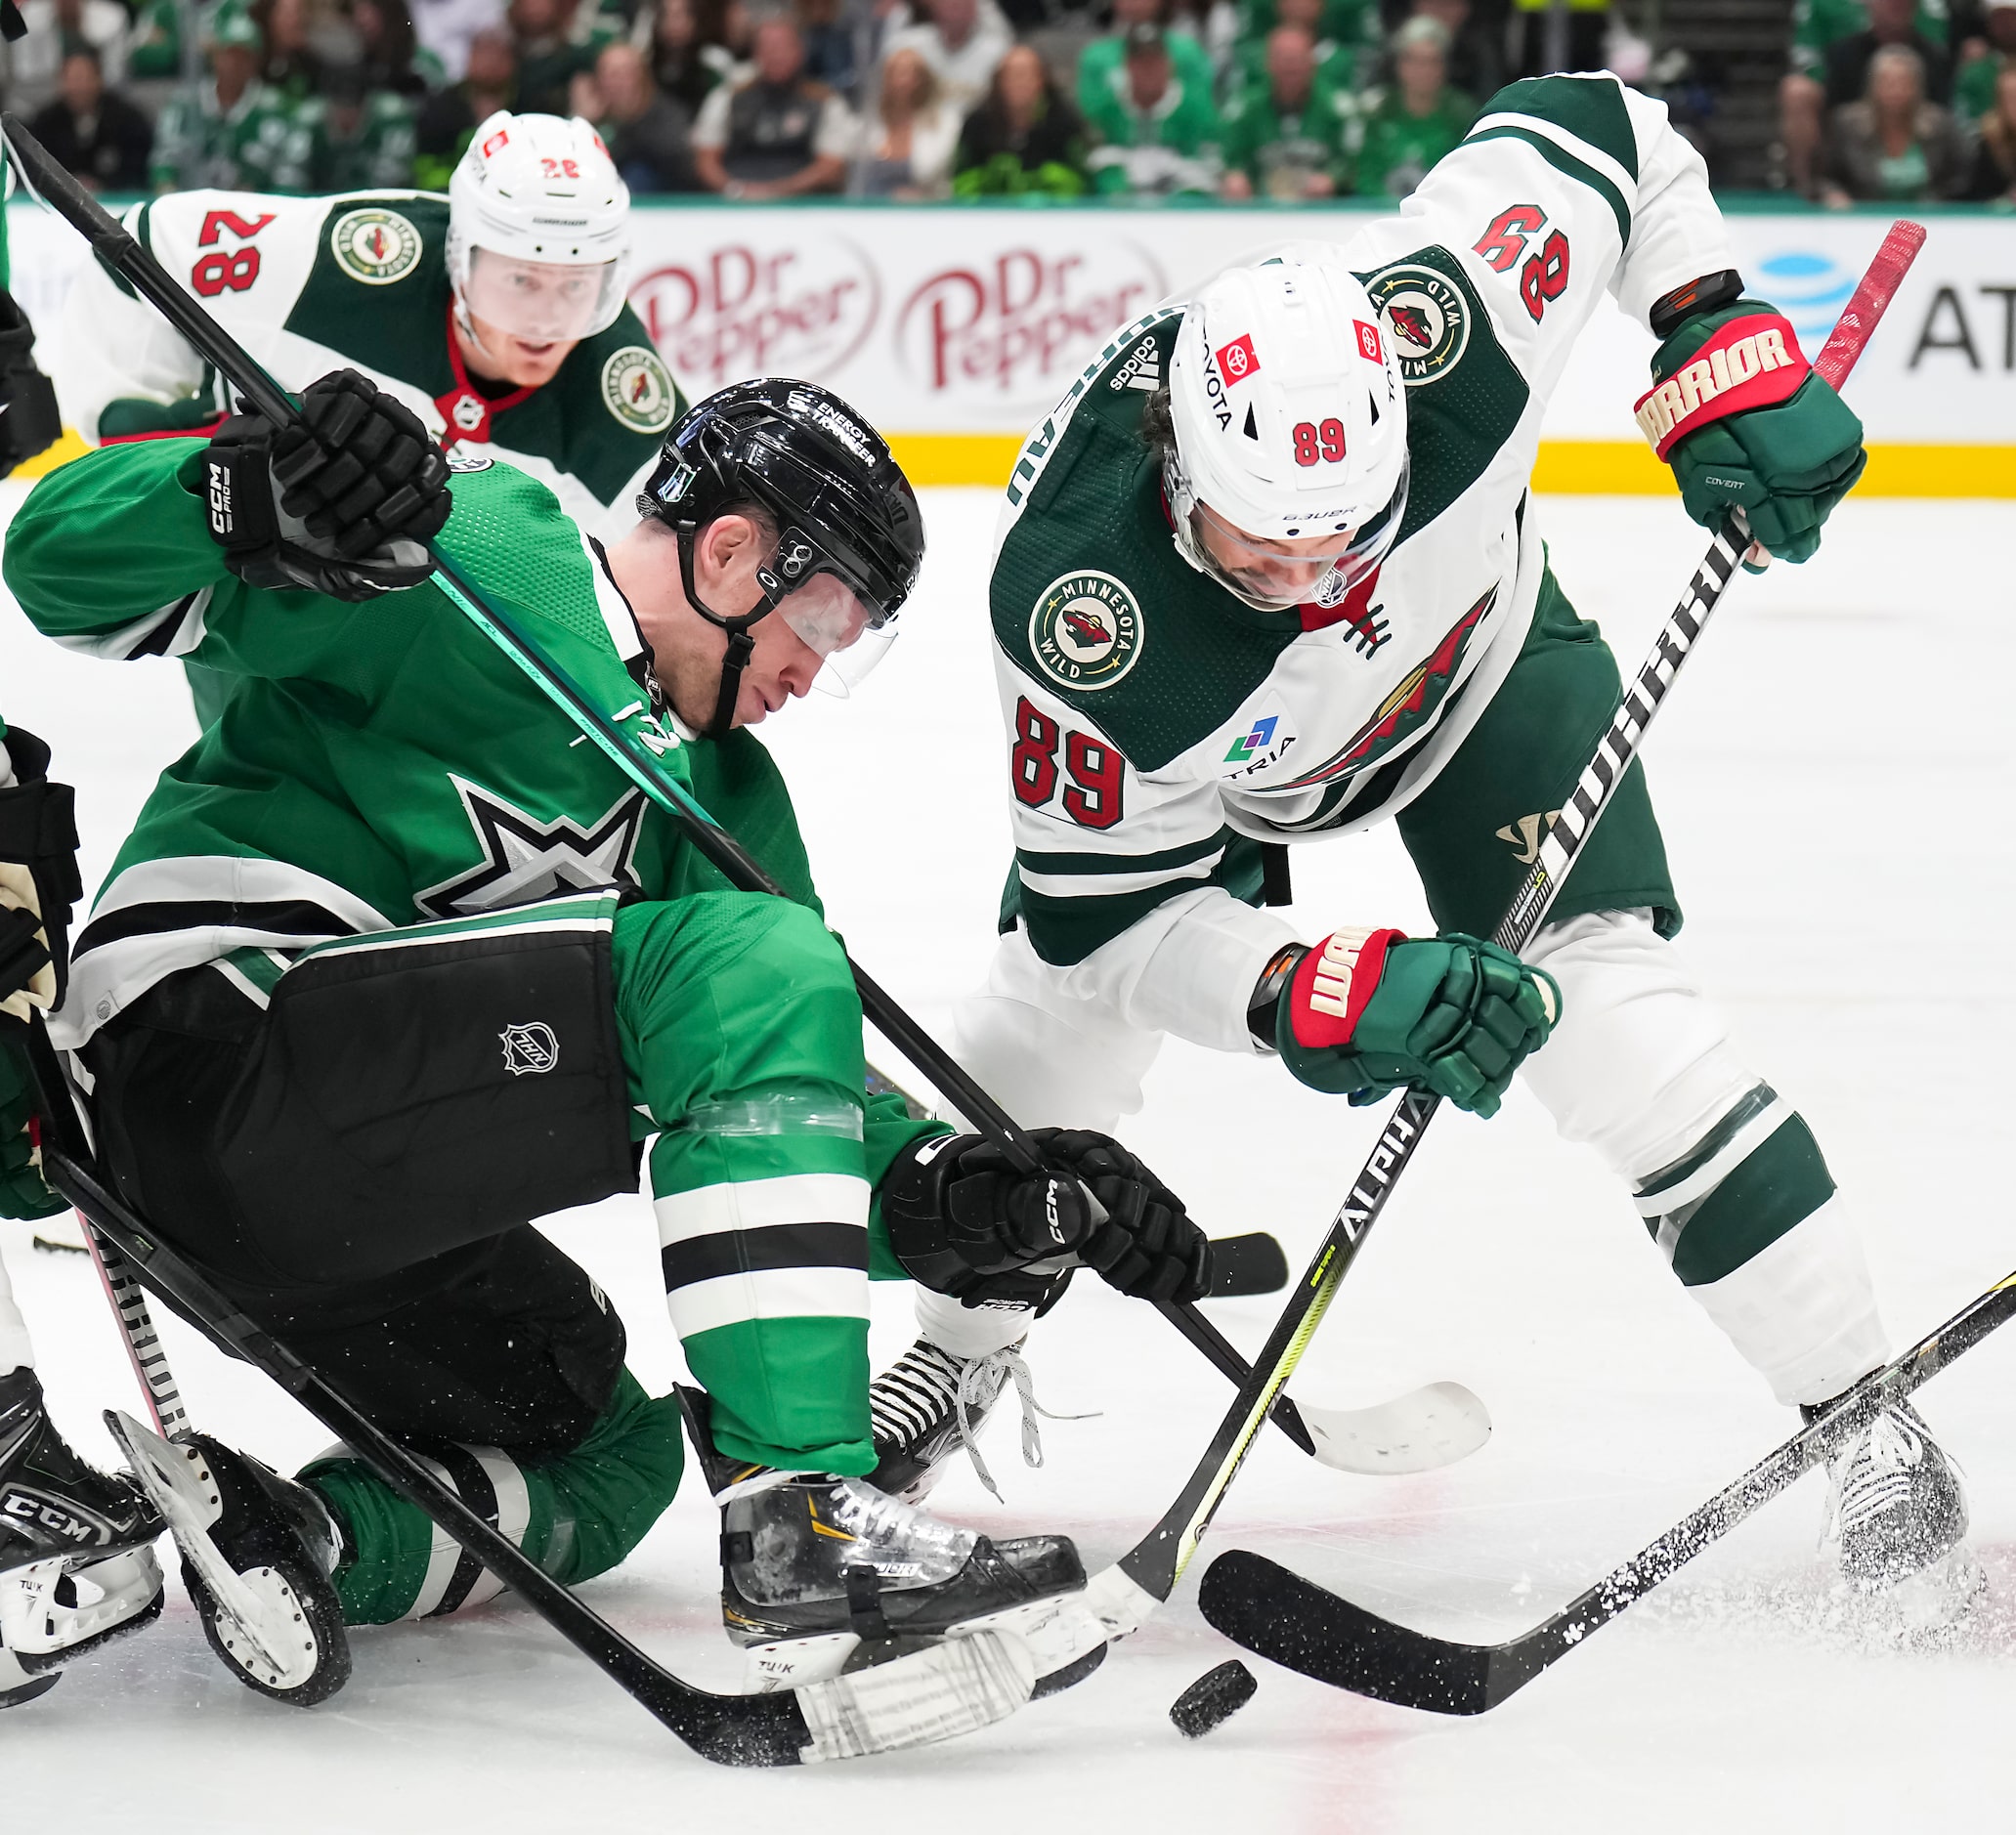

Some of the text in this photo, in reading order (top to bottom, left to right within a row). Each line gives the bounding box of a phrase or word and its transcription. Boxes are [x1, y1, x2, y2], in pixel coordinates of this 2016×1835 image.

[193, 210, 278, 298] 28
[707, 244, 795, 312] Dr
[994, 245, 1082, 315] Dr
[1470, 203, 1571, 325] 89
[1424, 278, 1463, 328] WILD
[1109, 335, 1156, 392] adidas
[1636, 328, 1795, 453] ARRIOR
[816, 401, 872, 444] ENERGY
[1292, 417, 1347, 468] 89
[208, 462, 225, 534] CCM
[222, 485, 233, 514] PRO
[1705, 476, 1745, 490] COVERT
[1061, 579, 1135, 652] MINNESOTA
[1039, 636, 1082, 680] WILD
[1011, 695, 1126, 831] 89
[1222, 736, 1297, 781] TRIA
[515, 1034, 549, 1063] NHL
[1340, 1090, 1434, 1243] ALPHA
[1046, 1178, 1066, 1245] CCM
[3, 1493, 93, 1543] CCM
